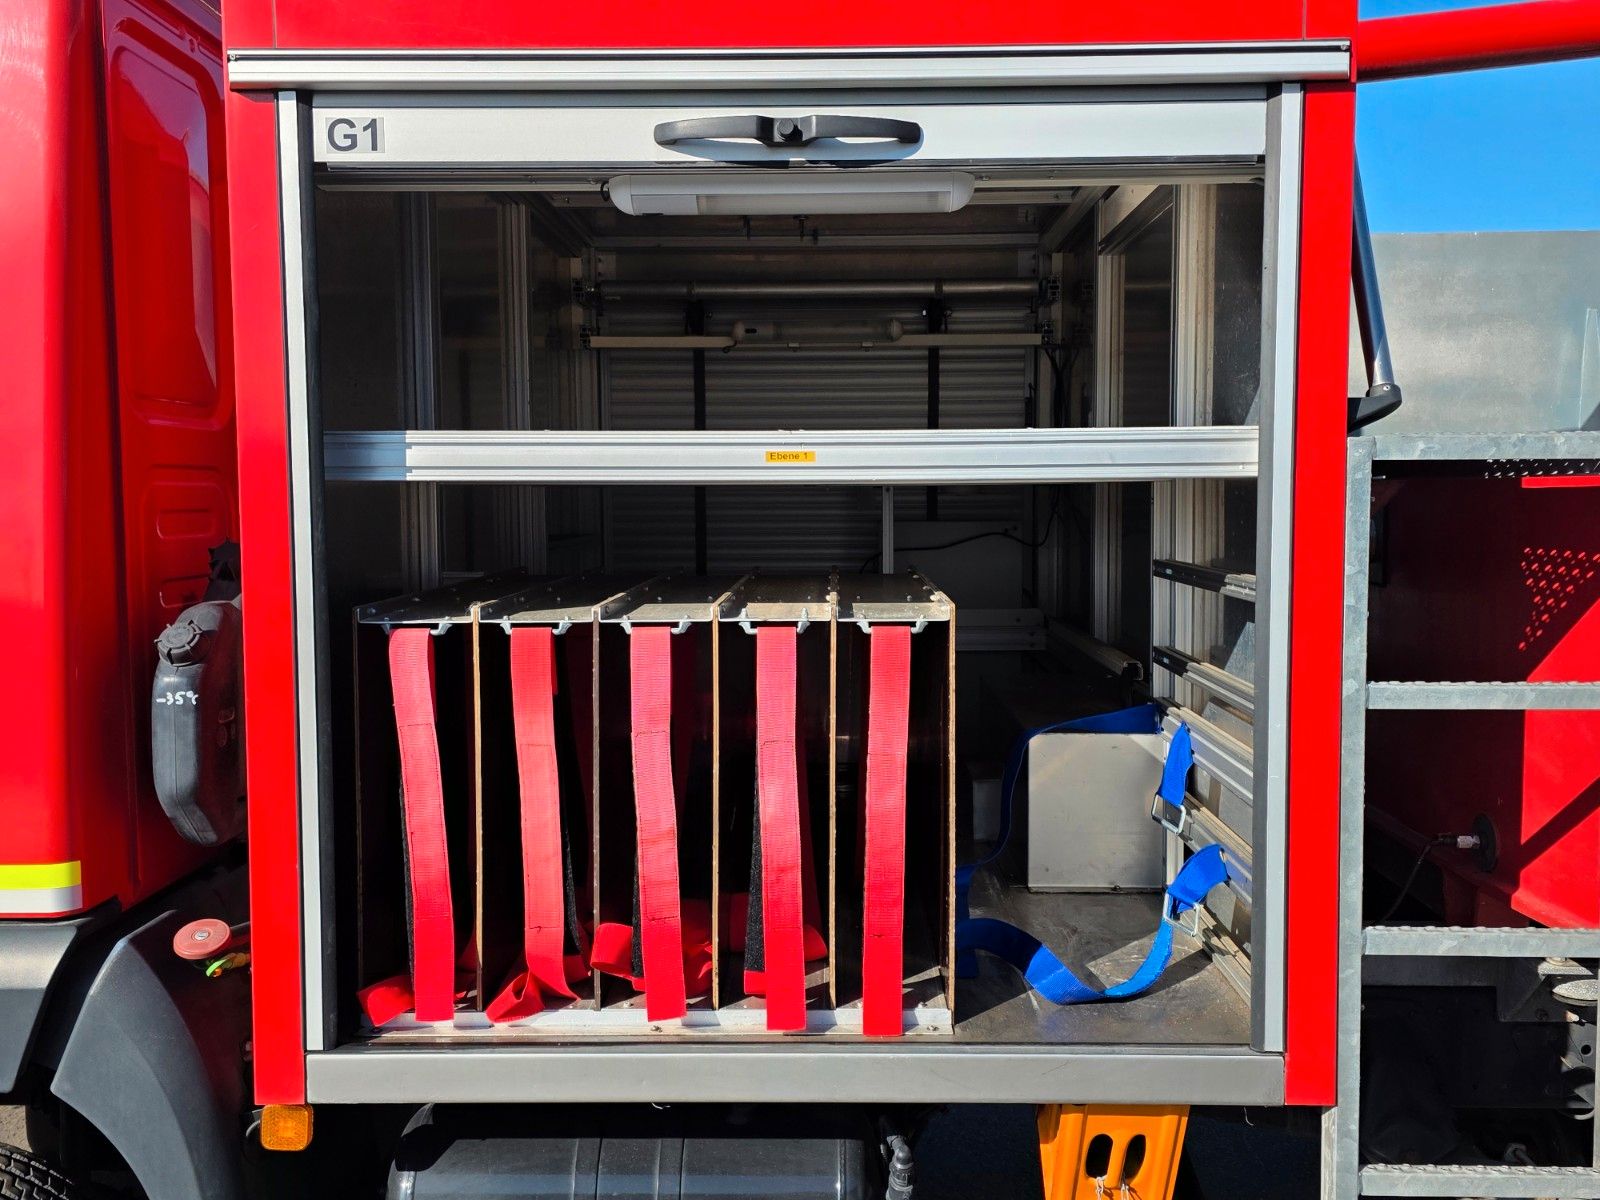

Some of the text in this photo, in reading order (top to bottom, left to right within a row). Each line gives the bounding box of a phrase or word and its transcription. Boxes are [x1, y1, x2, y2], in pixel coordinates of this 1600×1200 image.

[327, 117, 378, 152] G1
[770, 451, 808, 460] Ebene 1
